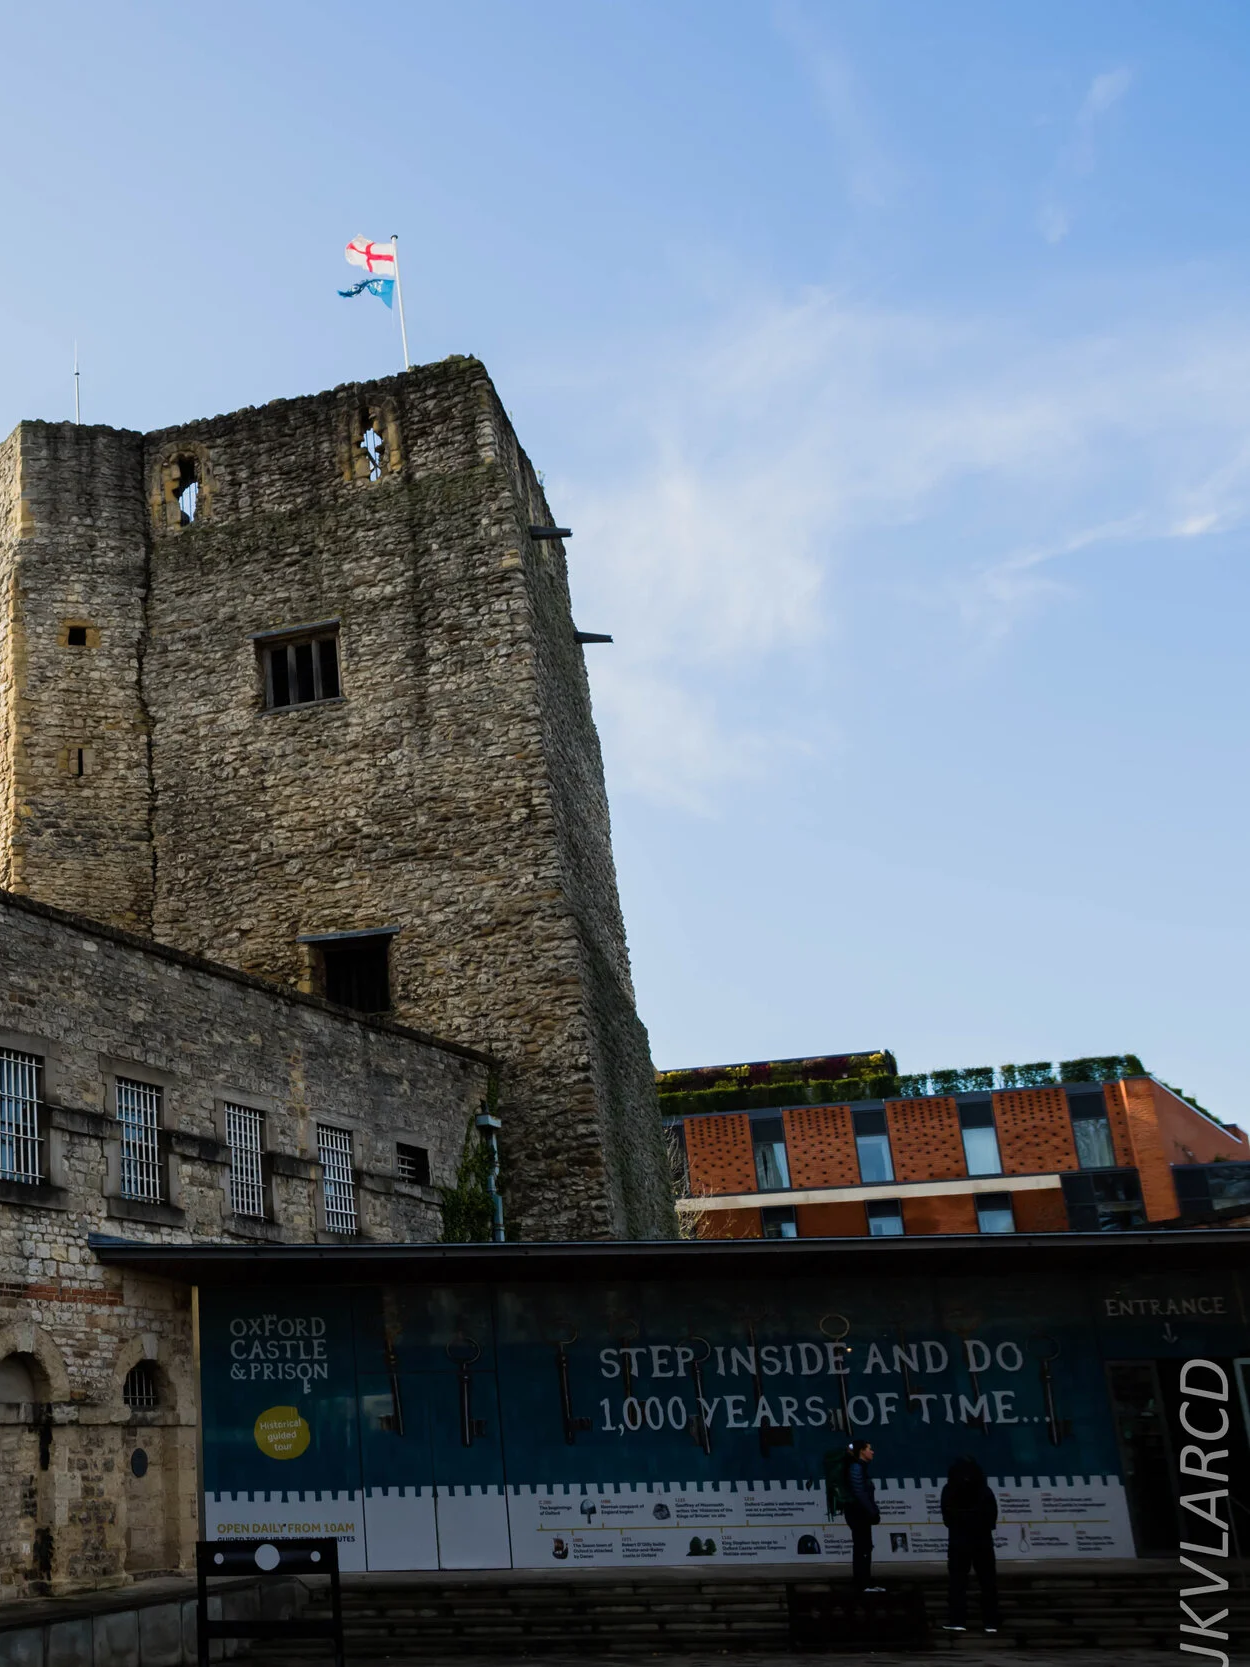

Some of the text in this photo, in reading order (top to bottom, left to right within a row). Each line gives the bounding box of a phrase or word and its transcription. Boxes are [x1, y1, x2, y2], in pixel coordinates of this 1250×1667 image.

[1104, 1296, 1228, 1317] ENTRANCE
[230, 1316, 326, 1337] OXFORD
[230, 1339, 327, 1360] CASTLE
[599, 1339, 1025, 1379] STEP INSIDE AND DO
[598, 1389, 1051, 1437] 1,000 YEARS OF TIME...
[260, 1418, 302, 1431] Historical
[267, 1430, 297, 1442] guided
[273, 1441, 293, 1451] tour
[217, 1523, 355, 1534] OPEN DAILY FROM 10AM
